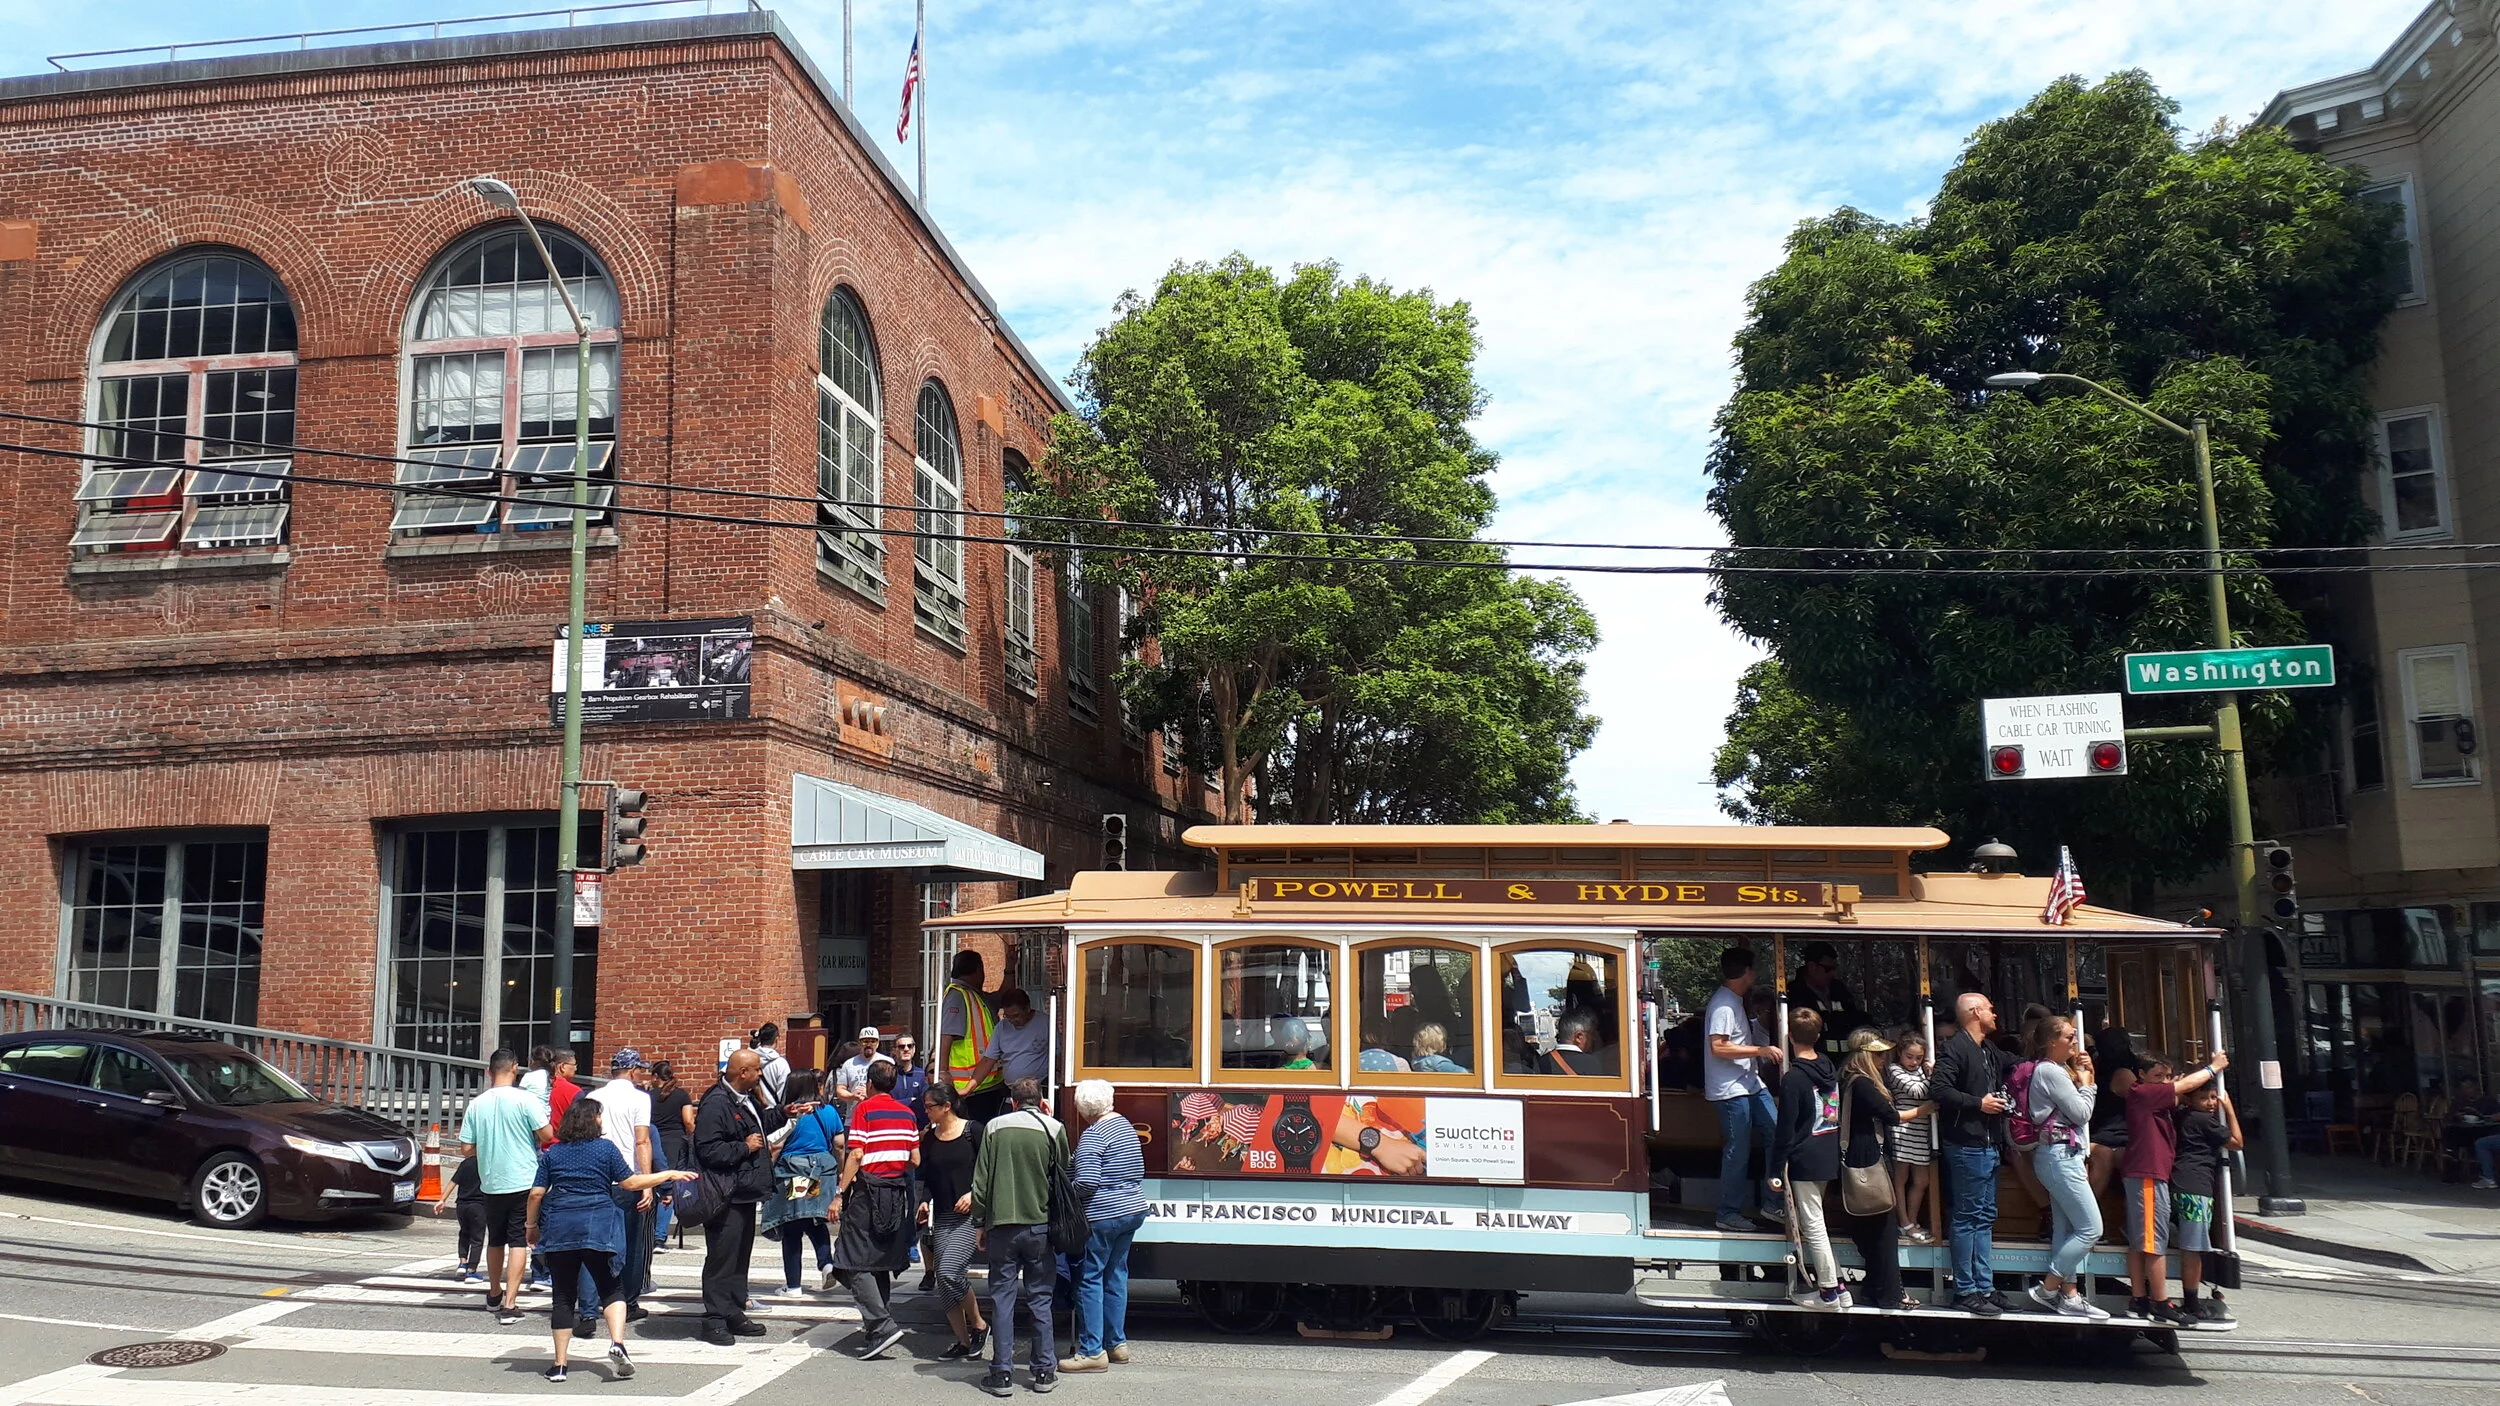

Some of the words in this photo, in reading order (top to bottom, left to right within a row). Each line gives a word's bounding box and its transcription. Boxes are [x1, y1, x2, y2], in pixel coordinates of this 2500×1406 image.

[582, 623, 614, 633] NESF
[2138, 659, 2322, 684] Washington
[603, 694, 633, 703] Propulsion
[633, 693, 659, 701] Gearbox
[660, 692, 699, 700] Rehabilitation
[2009, 704, 2041, 718] WHEN
[2046, 701, 2099, 717] FLASHING
[1998, 724, 2032, 738] CABLE
[2037, 722, 2059, 737] CAR
[2063, 720, 2112, 735] TURNING
[2039, 749, 2074, 767] WAIT
[800, 849, 844, 862] CABLE
[847, 848, 875, 861] CAR
[880, 846, 938, 860] MUSEUM
[954, 845, 966, 861] SAN
[1274, 881, 1463, 900] POWELL
[1507, 883, 1537, 900] &
[1577, 884, 1707, 902] HYDE
[1738, 885, 1808, 903] Sts.
[821, 955, 836, 969] CAR
[838, 955, 866, 969] MUSEUM
[1435, 1126, 1502, 1141] swatch
[1250, 1150, 1276, 1162] BIG
[1250, 1161, 1277, 1169] BOLD
[1148, 1203, 1177, 1218] AN
[1186, 1203, 1317, 1222] FRANCISCO
[1332, 1209, 1453, 1226] MUNICIPAL
[1476, 1212, 1573, 1230] RAILWAY
